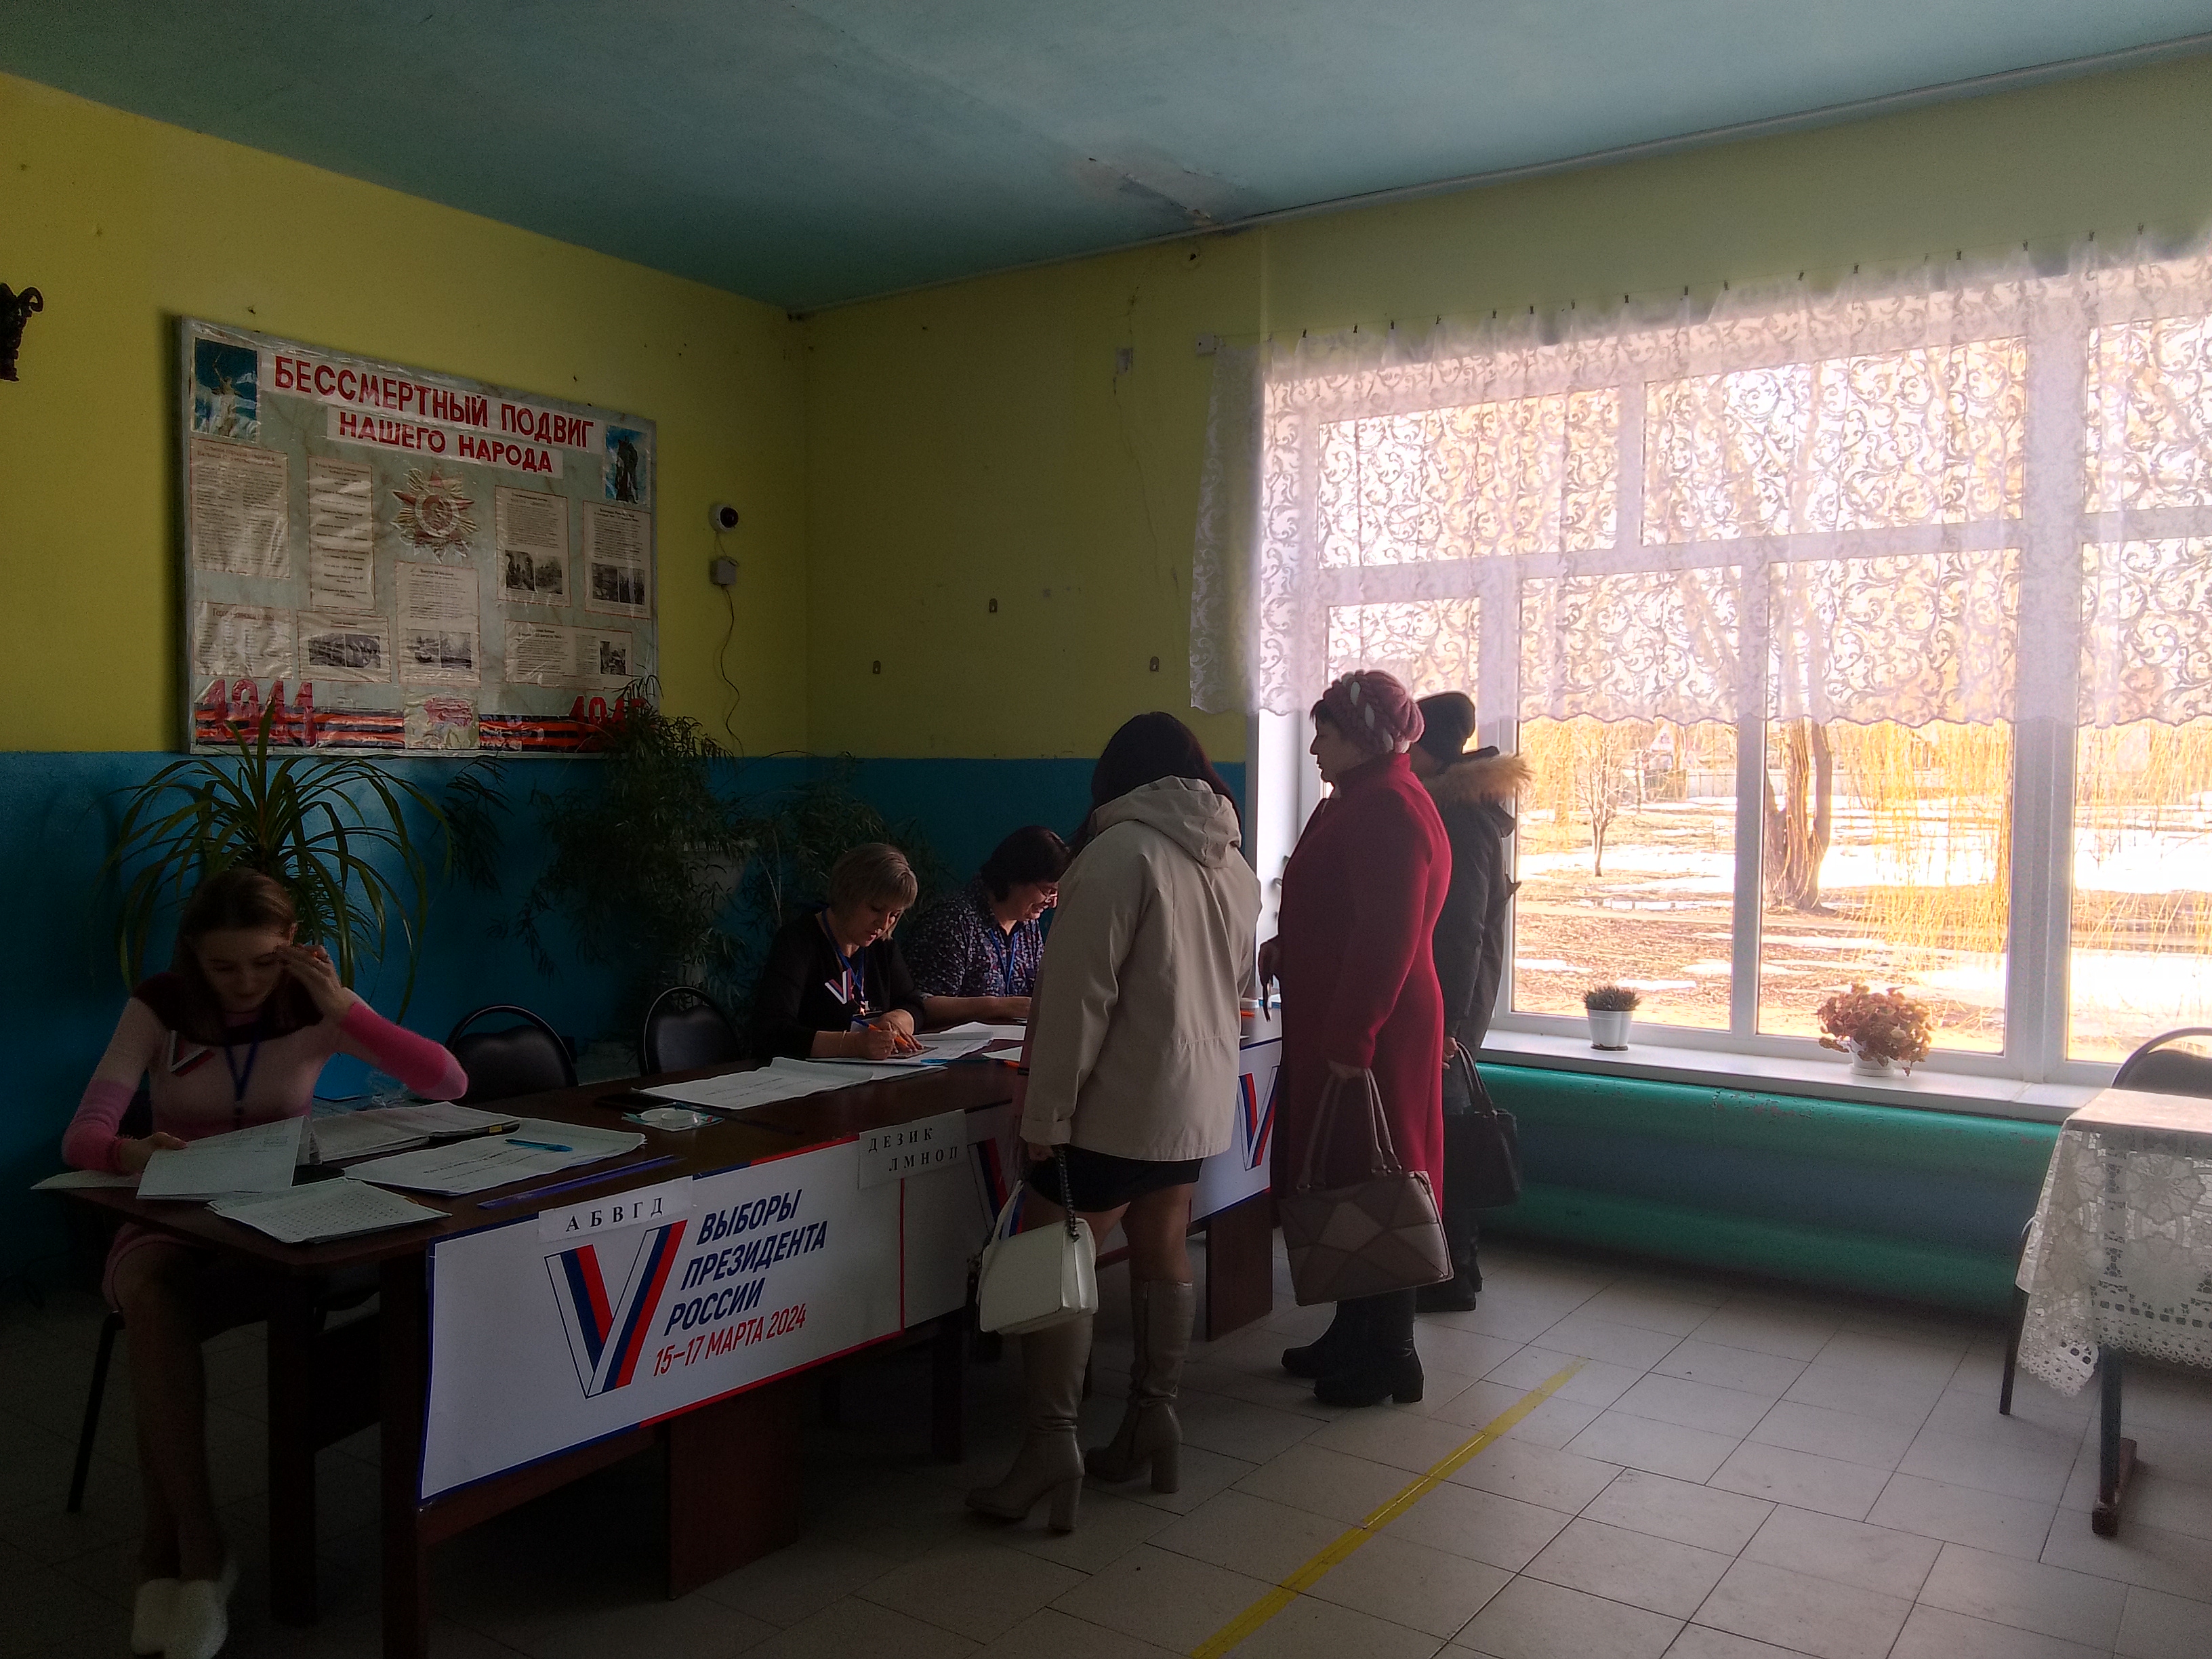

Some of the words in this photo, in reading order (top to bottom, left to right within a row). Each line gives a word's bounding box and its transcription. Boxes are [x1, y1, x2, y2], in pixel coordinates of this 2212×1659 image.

[275, 355, 488, 428] БЕССМЕРТНЫЙ
[501, 403, 594, 448] ПОДВИГ
[340, 411, 446, 453] НАШЕГО
[459, 434, 553, 473] НАРОДА
[697, 1189, 802, 1246] ВЫБОРЫ
[680, 1221, 828, 1291] ПРЕЗИДЕНТА
[663, 1277, 766, 1336] РОССИИ
[705, 1316, 764, 1359] МАРТА
[766, 1303, 807, 1338] 2024
